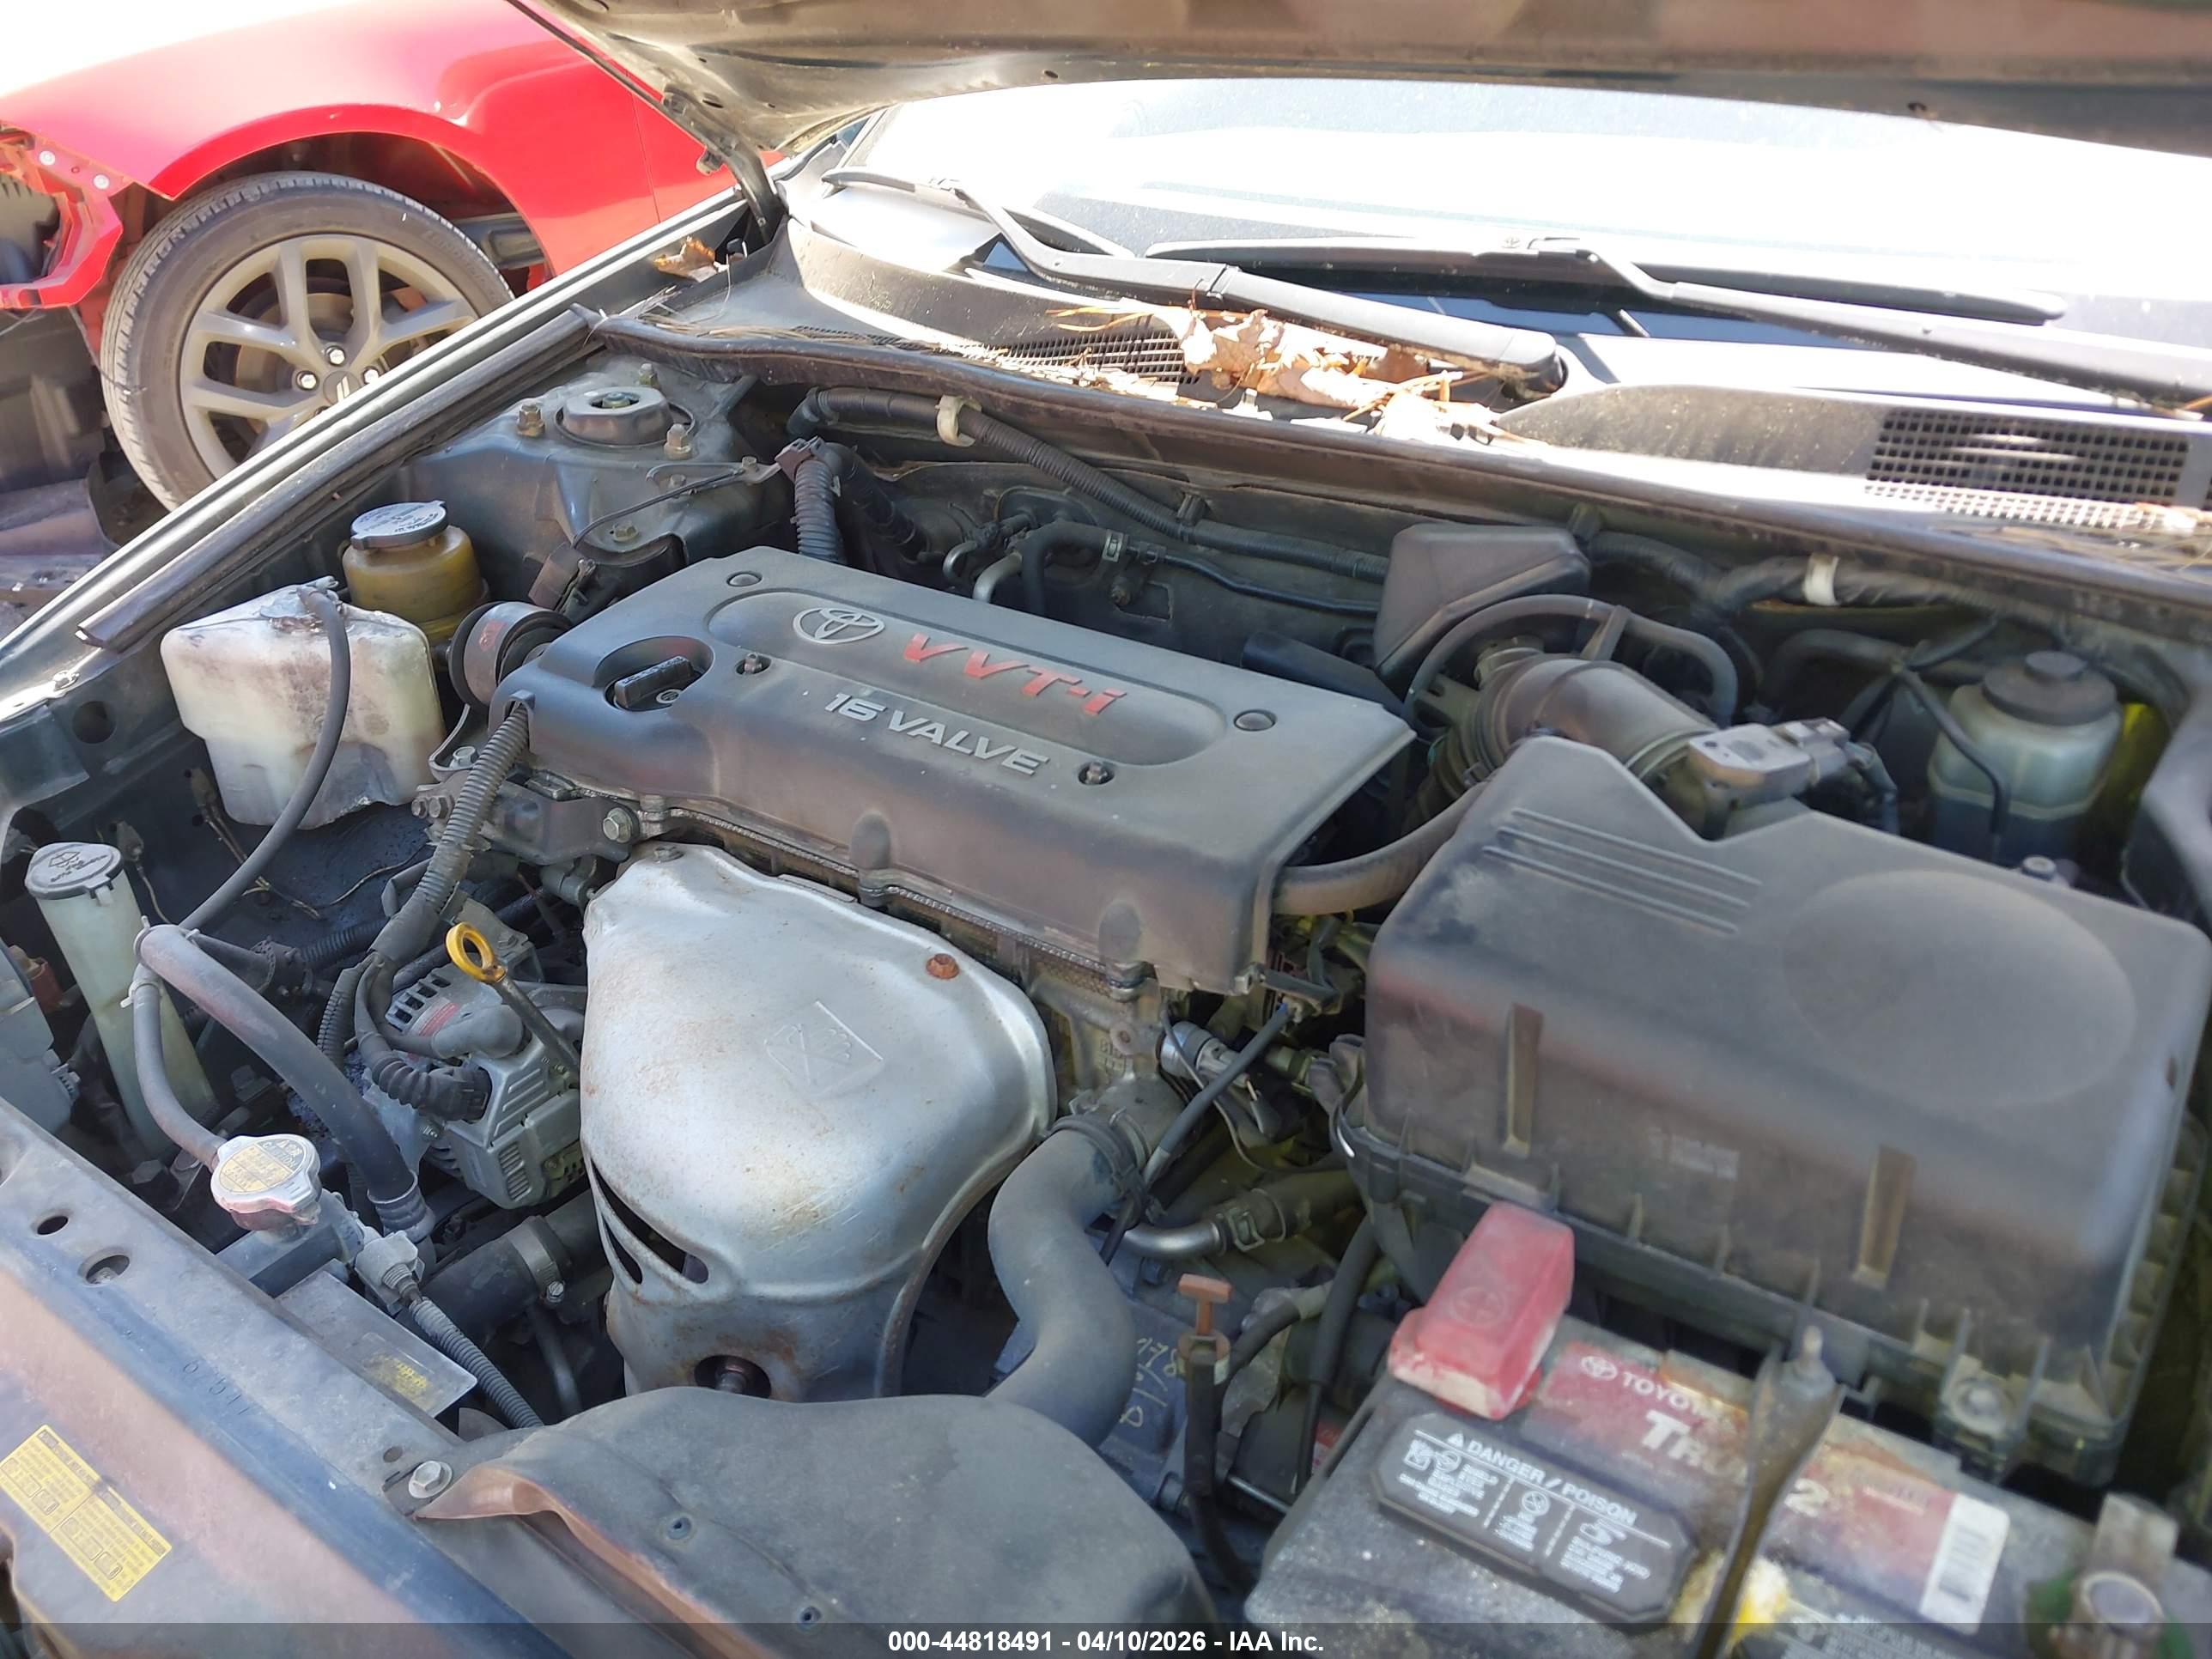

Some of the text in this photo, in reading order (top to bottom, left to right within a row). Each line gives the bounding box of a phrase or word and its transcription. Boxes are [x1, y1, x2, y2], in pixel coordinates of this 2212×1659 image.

[903, 633, 1127, 715] VVT-i
[824, 692, 1050, 775] 16 VALVE
[1467, 1440, 1547, 1485] DANGER
[1562, 1482, 1638, 1526] POISON
